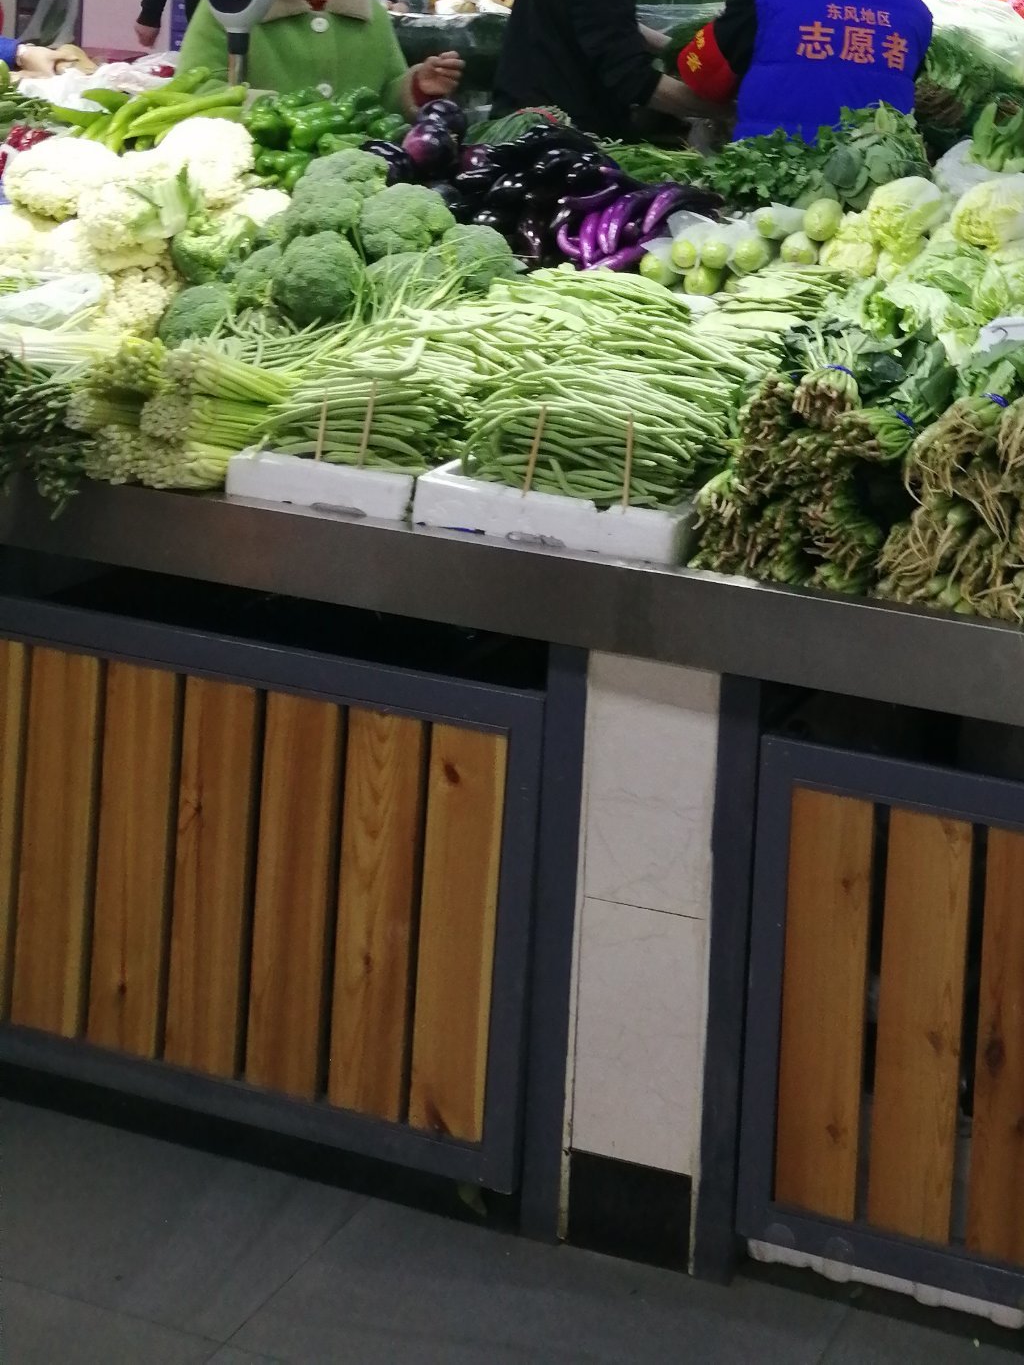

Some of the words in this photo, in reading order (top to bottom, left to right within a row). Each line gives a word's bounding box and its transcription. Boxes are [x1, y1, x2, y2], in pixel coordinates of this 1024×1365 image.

[826, 3, 892, 28] 东风地区
[795, 20, 909, 72] 志愿者
